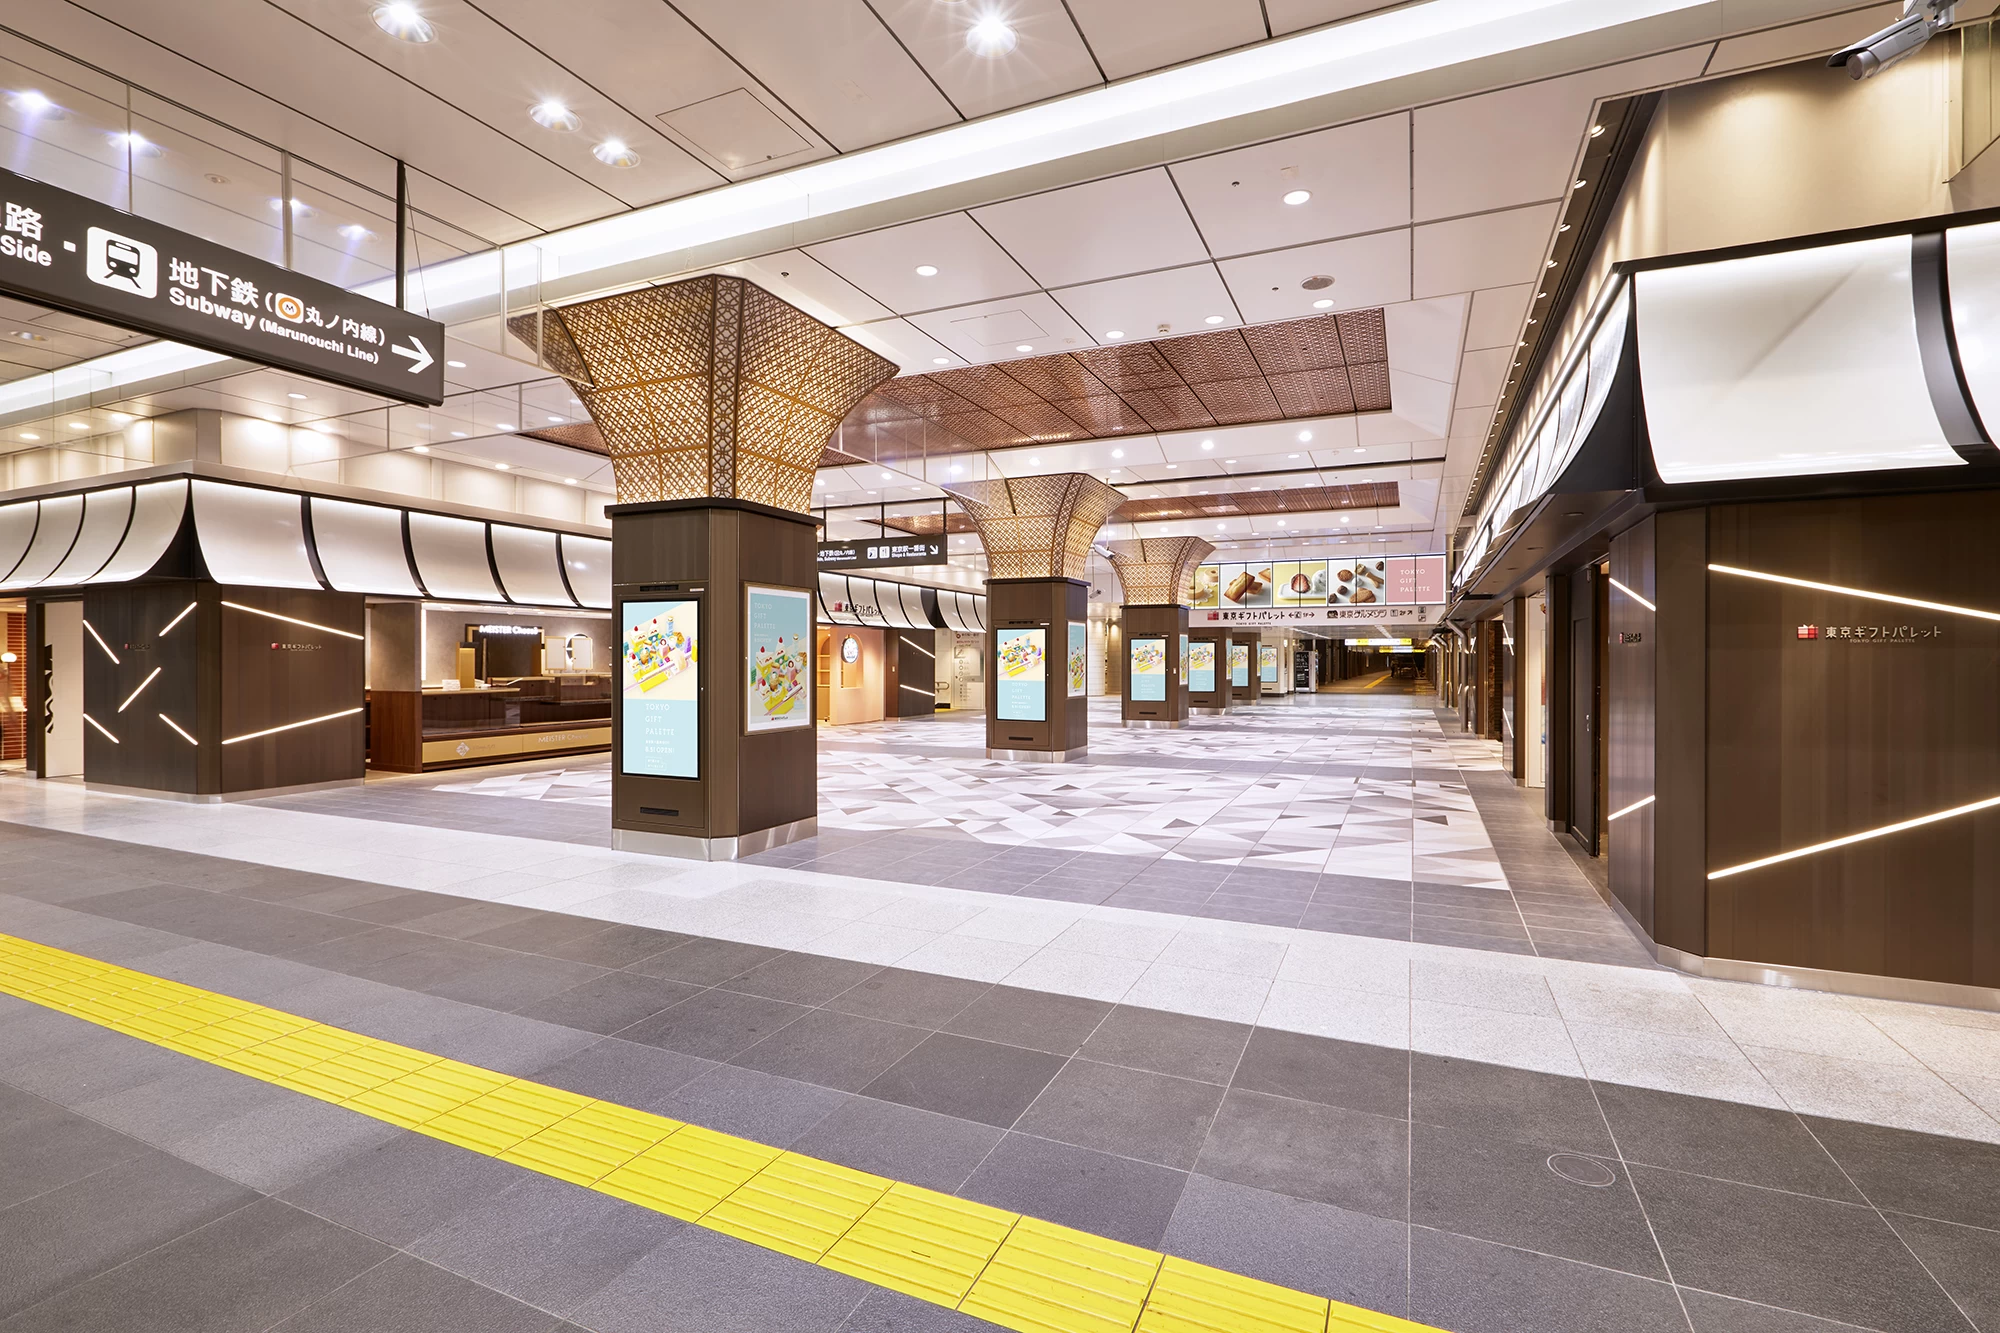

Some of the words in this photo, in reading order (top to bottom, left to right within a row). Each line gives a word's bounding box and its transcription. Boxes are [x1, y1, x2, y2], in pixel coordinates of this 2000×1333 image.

[0, 202, 43, 241] 路
[0, 234, 52, 267] Side
[169, 257, 259, 309] 地下鉄
[169, 286, 256, 330] Subway
[259, 317, 344, 354] (Marunouchi
[347, 344, 379, 365] Line)
[754, 602, 772, 610] TOKYO
[1222, 611, 1285, 621] 東京ギフトパレット
[1339, 609, 1388, 619] 東京グルメゾン
[1825, 625, 1942, 639] 東京ギフトパレット
[645, 703, 670, 711] TOKYO
[645, 715, 663, 723] GIFT
[645, 728, 675, 736] PALETTE
[538, 734, 566, 743] MEISTER
